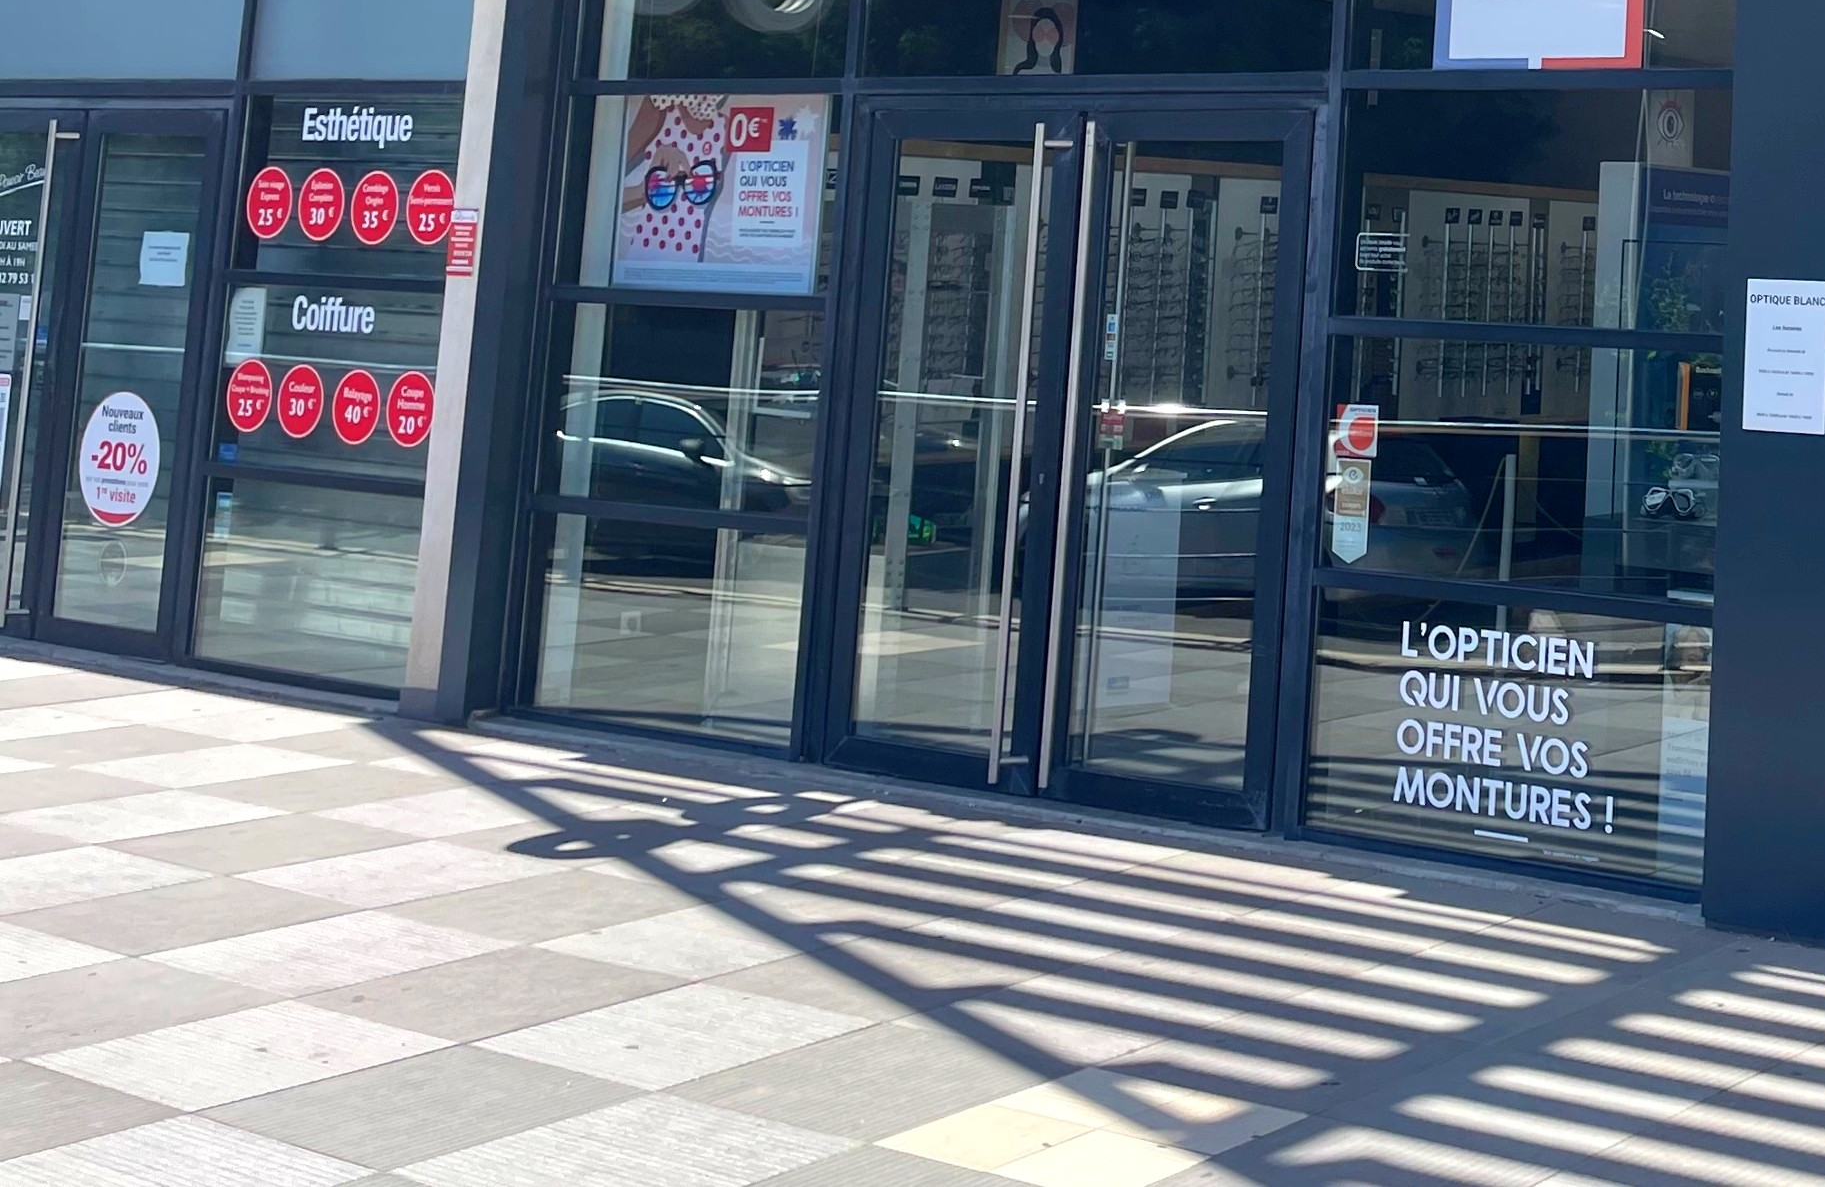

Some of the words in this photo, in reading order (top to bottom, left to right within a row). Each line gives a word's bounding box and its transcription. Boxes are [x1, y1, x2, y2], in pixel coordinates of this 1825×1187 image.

[302, 106, 413, 149] Esthétique
[741, 160, 794, 172] L'OPTICIEN
[740, 175, 757, 187] QUI
[760, 176, 787, 187] VOUS
[739, 191, 768, 202] OFFRE
[772, 191, 791, 202] VOS
[738, 206, 792, 217] MONTURES
[1750, 294, 1792, 305] OPTIQUE
[292, 295, 375, 334] Coiffure
[102, 405, 144, 420] Nouveaux
[108, 419, 137, 434] clients
[92, 440, 147, 475] -20%
[109, 487, 136, 503] visite
[1339, 521, 1362, 532] 2023
[1401, 621, 1594, 679] L'OPTICIEN
[1399, 670, 1460, 711] QUI
[1474, 678, 1569, 725] VOUS
[1397, 719, 1502, 767] OFFRE
[1517, 733, 1588, 779] VOS
[1393, 766, 1592, 830] MONTURES
